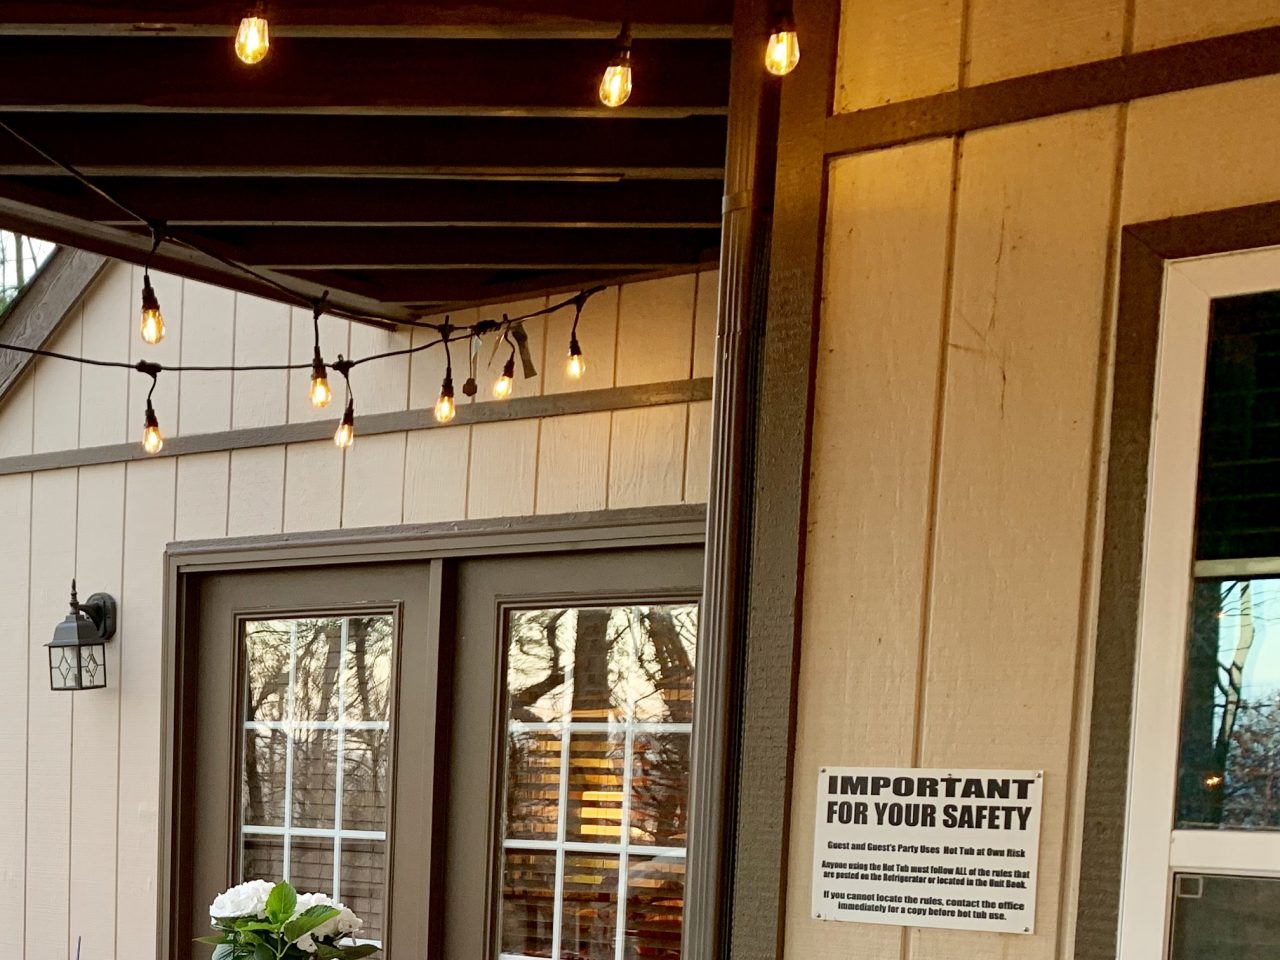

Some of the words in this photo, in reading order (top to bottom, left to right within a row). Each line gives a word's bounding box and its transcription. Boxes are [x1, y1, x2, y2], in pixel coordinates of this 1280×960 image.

[828, 776, 1034, 799] IMPORTANT
[827, 801, 868, 824] FOR
[875, 803, 936, 827] YOUR
[943, 804, 1032, 830] SAFETY
[828, 841, 849, 849] Guest
[851, 842, 865, 850] and
[867, 843, 896, 851] Guest's
[898, 844, 918, 853] Party
[920, 845, 940, 854] Uses
[944, 846, 957, 854] Hot
[959, 847, 974, 855] Tub
[987, 848, 1004, 856] Own
[1007, 849, 1025, 857] Risk
[822, 860, 847, 869] Anyone
[849, 862, 868, 871] using
[869, 863, 881, 871] the
[896, 864, 909, 872] Tub
[930, 866, 954, 874] follow
[955, 867, 967, 875] ALL
[978, 868, 990, 876] the
[992, 869, 1012, 877] rules
[1014, 870, 1030, 878] that
[871, 873, 881, 881] the
[883, 873, 926, 883] Refrigerator
[937, 876, 964, 885] located
[823, 890, 829, 898] If
[847, 893, 875, 901] cannot
[877, 894, 902, 902] locate
[904, 895, 918, 903] the
[946, 899, 980, 908] contact
[982, 900, 996, 908] the
[998, 901, 1024, 910] office
[888, 905, 899, 913] for
[907, 906, 927, 915] copy
[929, 908, 955, 916] before
[957, 910, 971, 918] hot
[973, 911, 987, 919] tub
